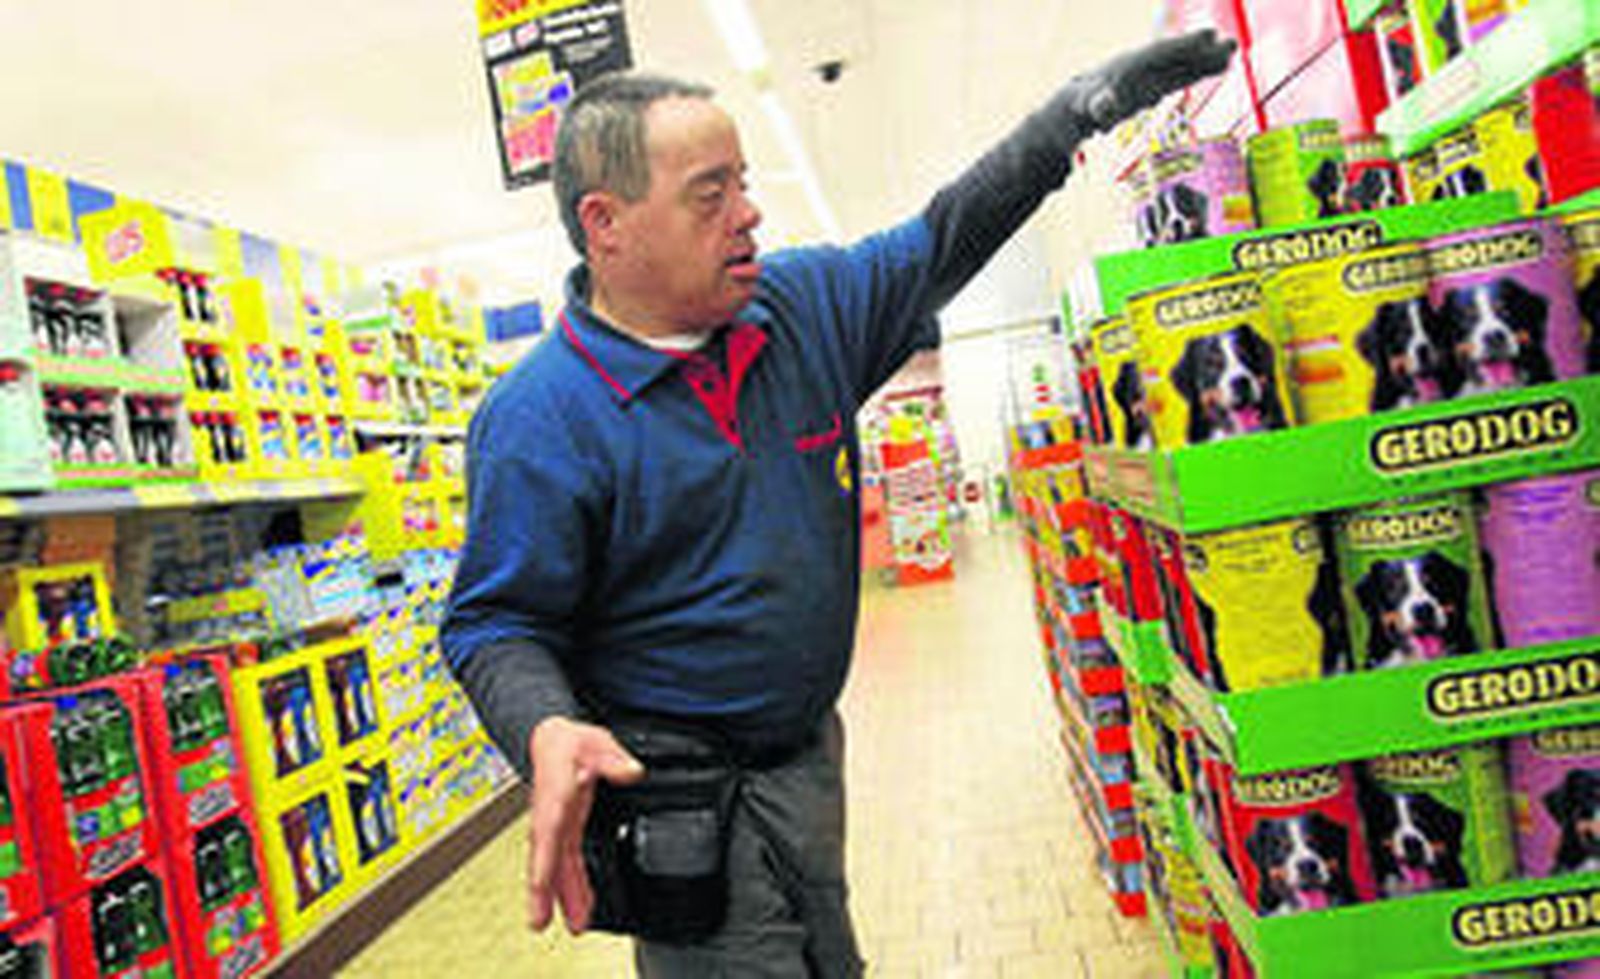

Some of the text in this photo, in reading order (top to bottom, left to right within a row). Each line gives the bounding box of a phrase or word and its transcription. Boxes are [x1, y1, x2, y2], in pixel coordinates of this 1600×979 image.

[1237, 225, 1378, 269] GERODOG
[1376, 403, 1571, 466] GERODOG
[1433, 658, 1600, 713] GERODO
